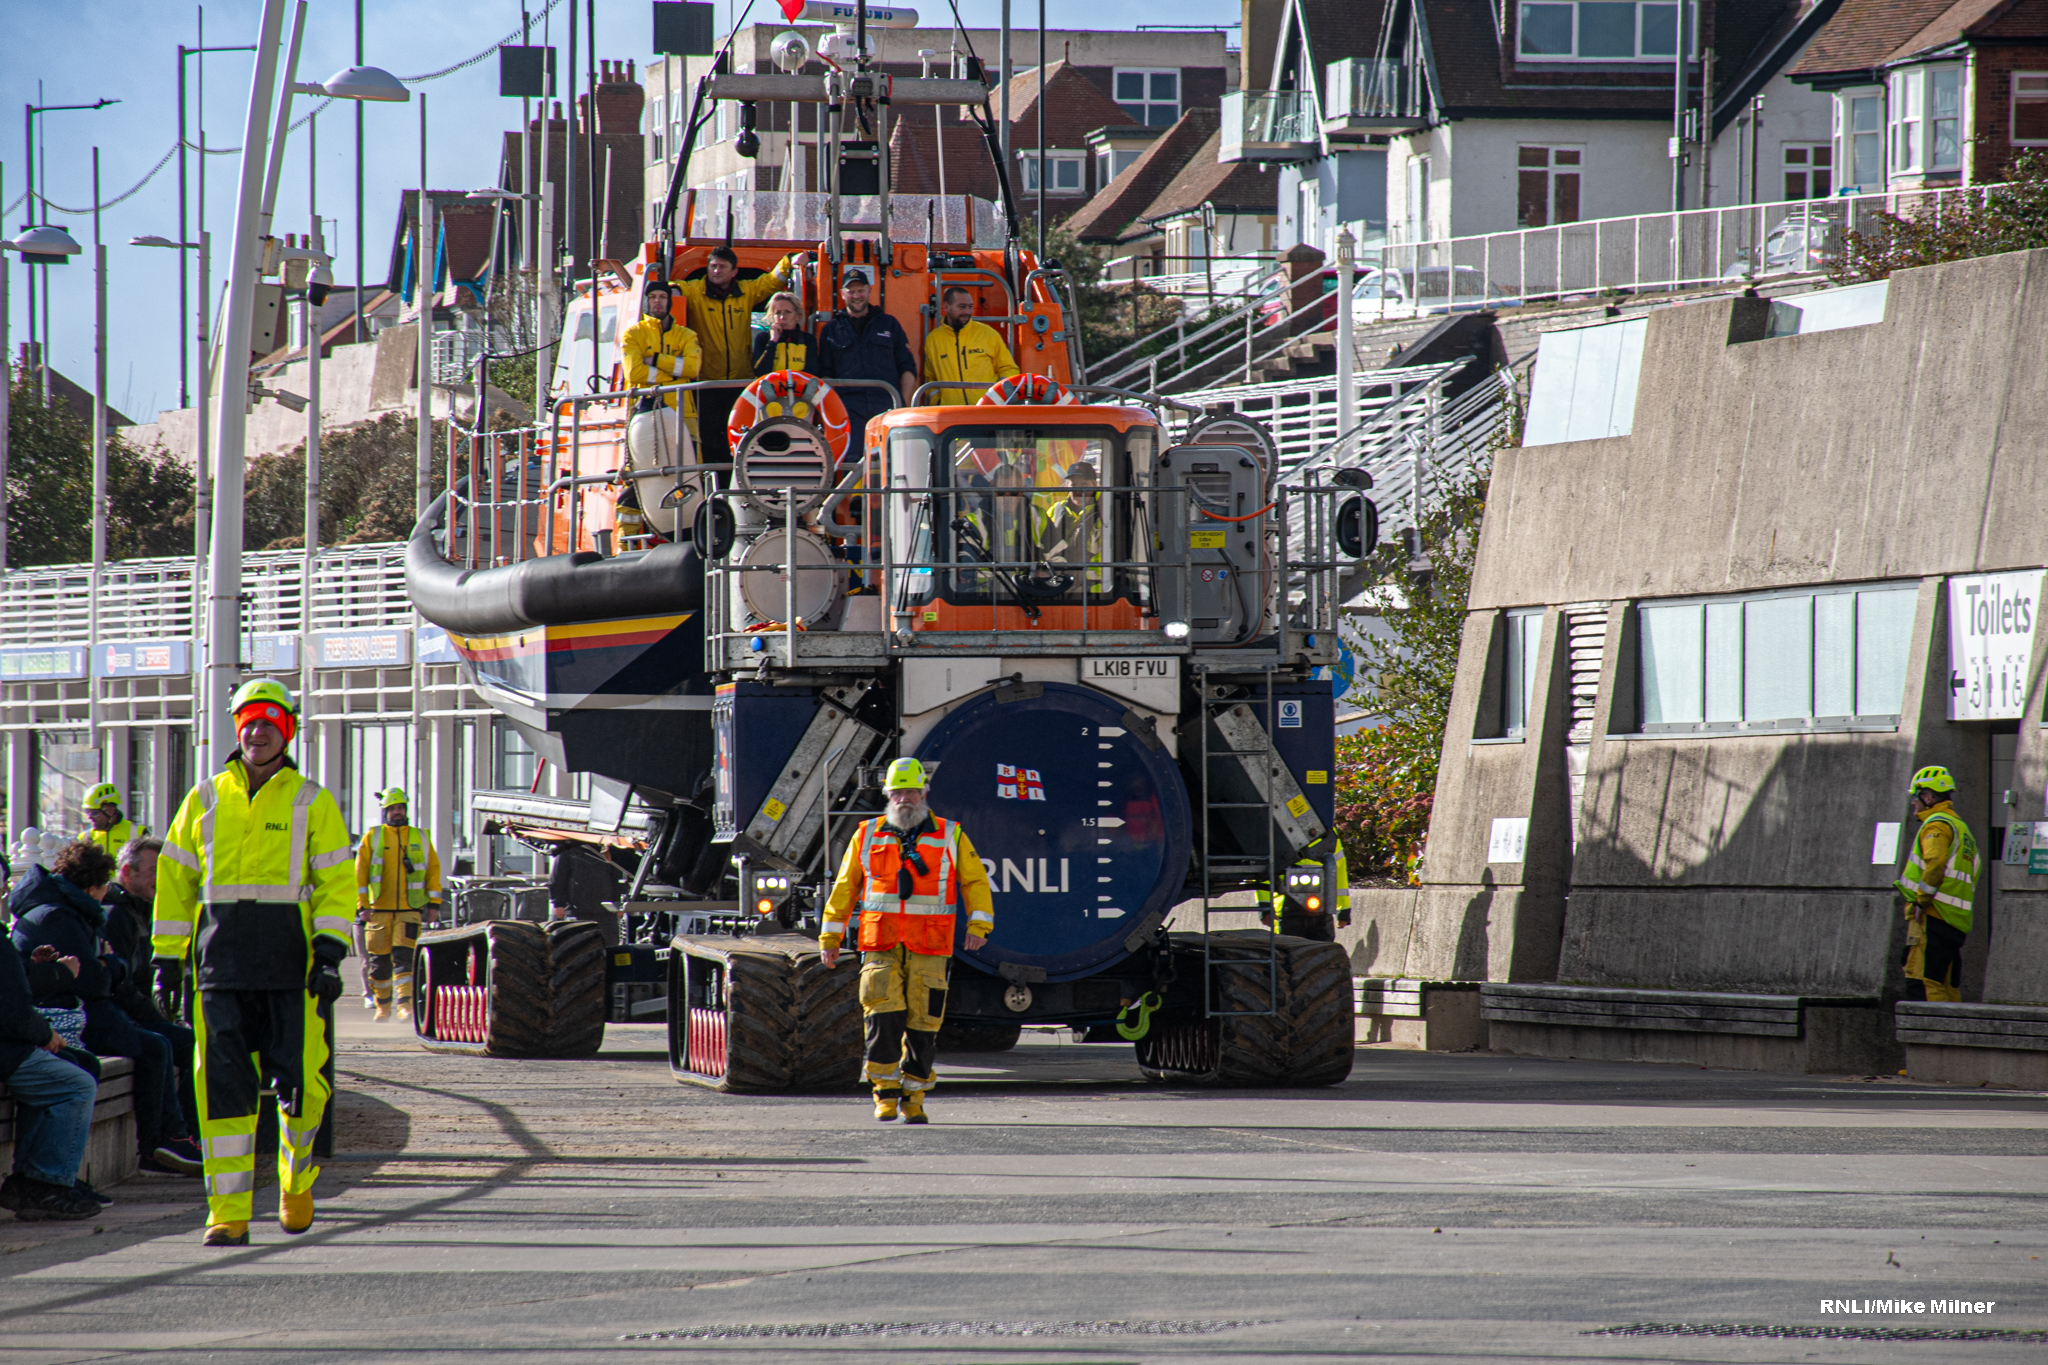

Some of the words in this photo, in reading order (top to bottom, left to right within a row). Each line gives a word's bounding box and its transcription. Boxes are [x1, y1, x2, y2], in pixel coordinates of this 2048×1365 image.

[833, 7, 893, 20] FUUNO
[1965, 583, 2031, 636] Toilets
[370, 635, 397, 660] COFFEE
[146, 652, 169, 665] SPORTS
[1094, 660, 1130, 676] LK18
[1135, 660, 1167, 676] FVU
[1081, 727, 1089, 736] 2
[265, 822, 288, 831] RNLI
[1081, 818, 1096, 827] 1.5
[980, 858, 1069, 893] RNLI
[1083, 909, 1089, 918] 1
